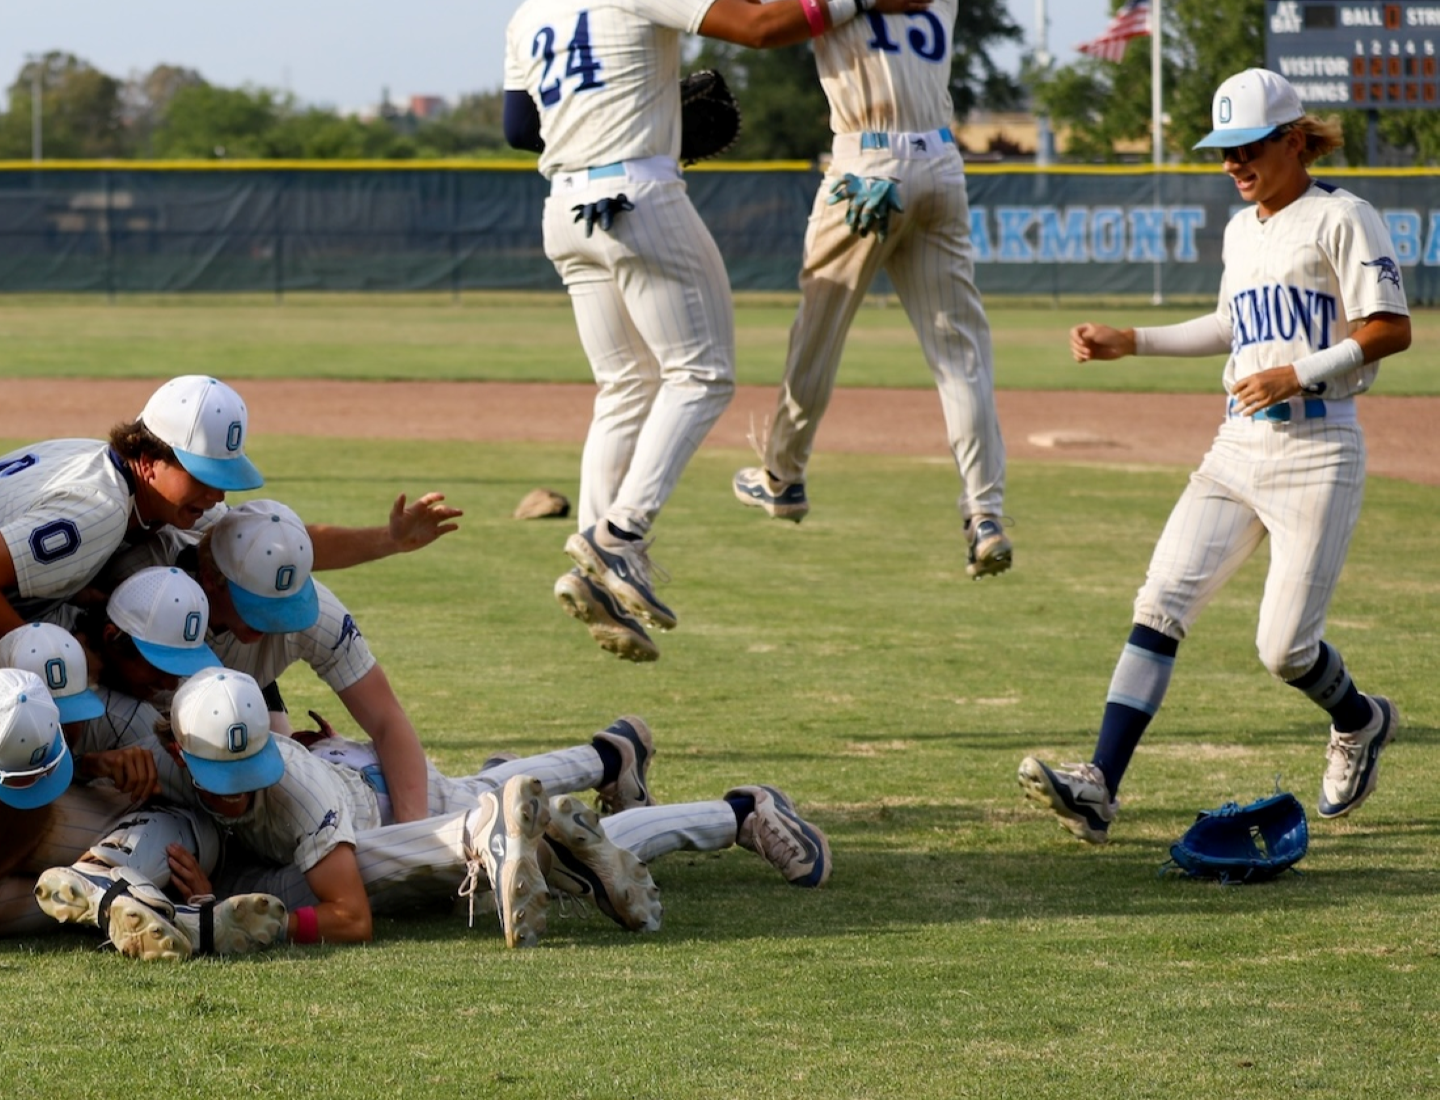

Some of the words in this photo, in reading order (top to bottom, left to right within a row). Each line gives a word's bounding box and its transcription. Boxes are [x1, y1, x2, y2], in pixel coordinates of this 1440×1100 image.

[1270, 14, 1302, 34] BAT
[1341, 7, 1383, 27] BALL
[532, 9, 606, 109] 24
[1279, 56, 1349, 77] VISITOR
[1219, 96, 1232, 124] O
[226, 420, 242, 451] O
[28, 518, 82, 565] O
[275, 564, 296, 591] O
[183, 611, 201, 642] O
[45, 658, 68, 690] O
[227, 722, 248, 752] O
